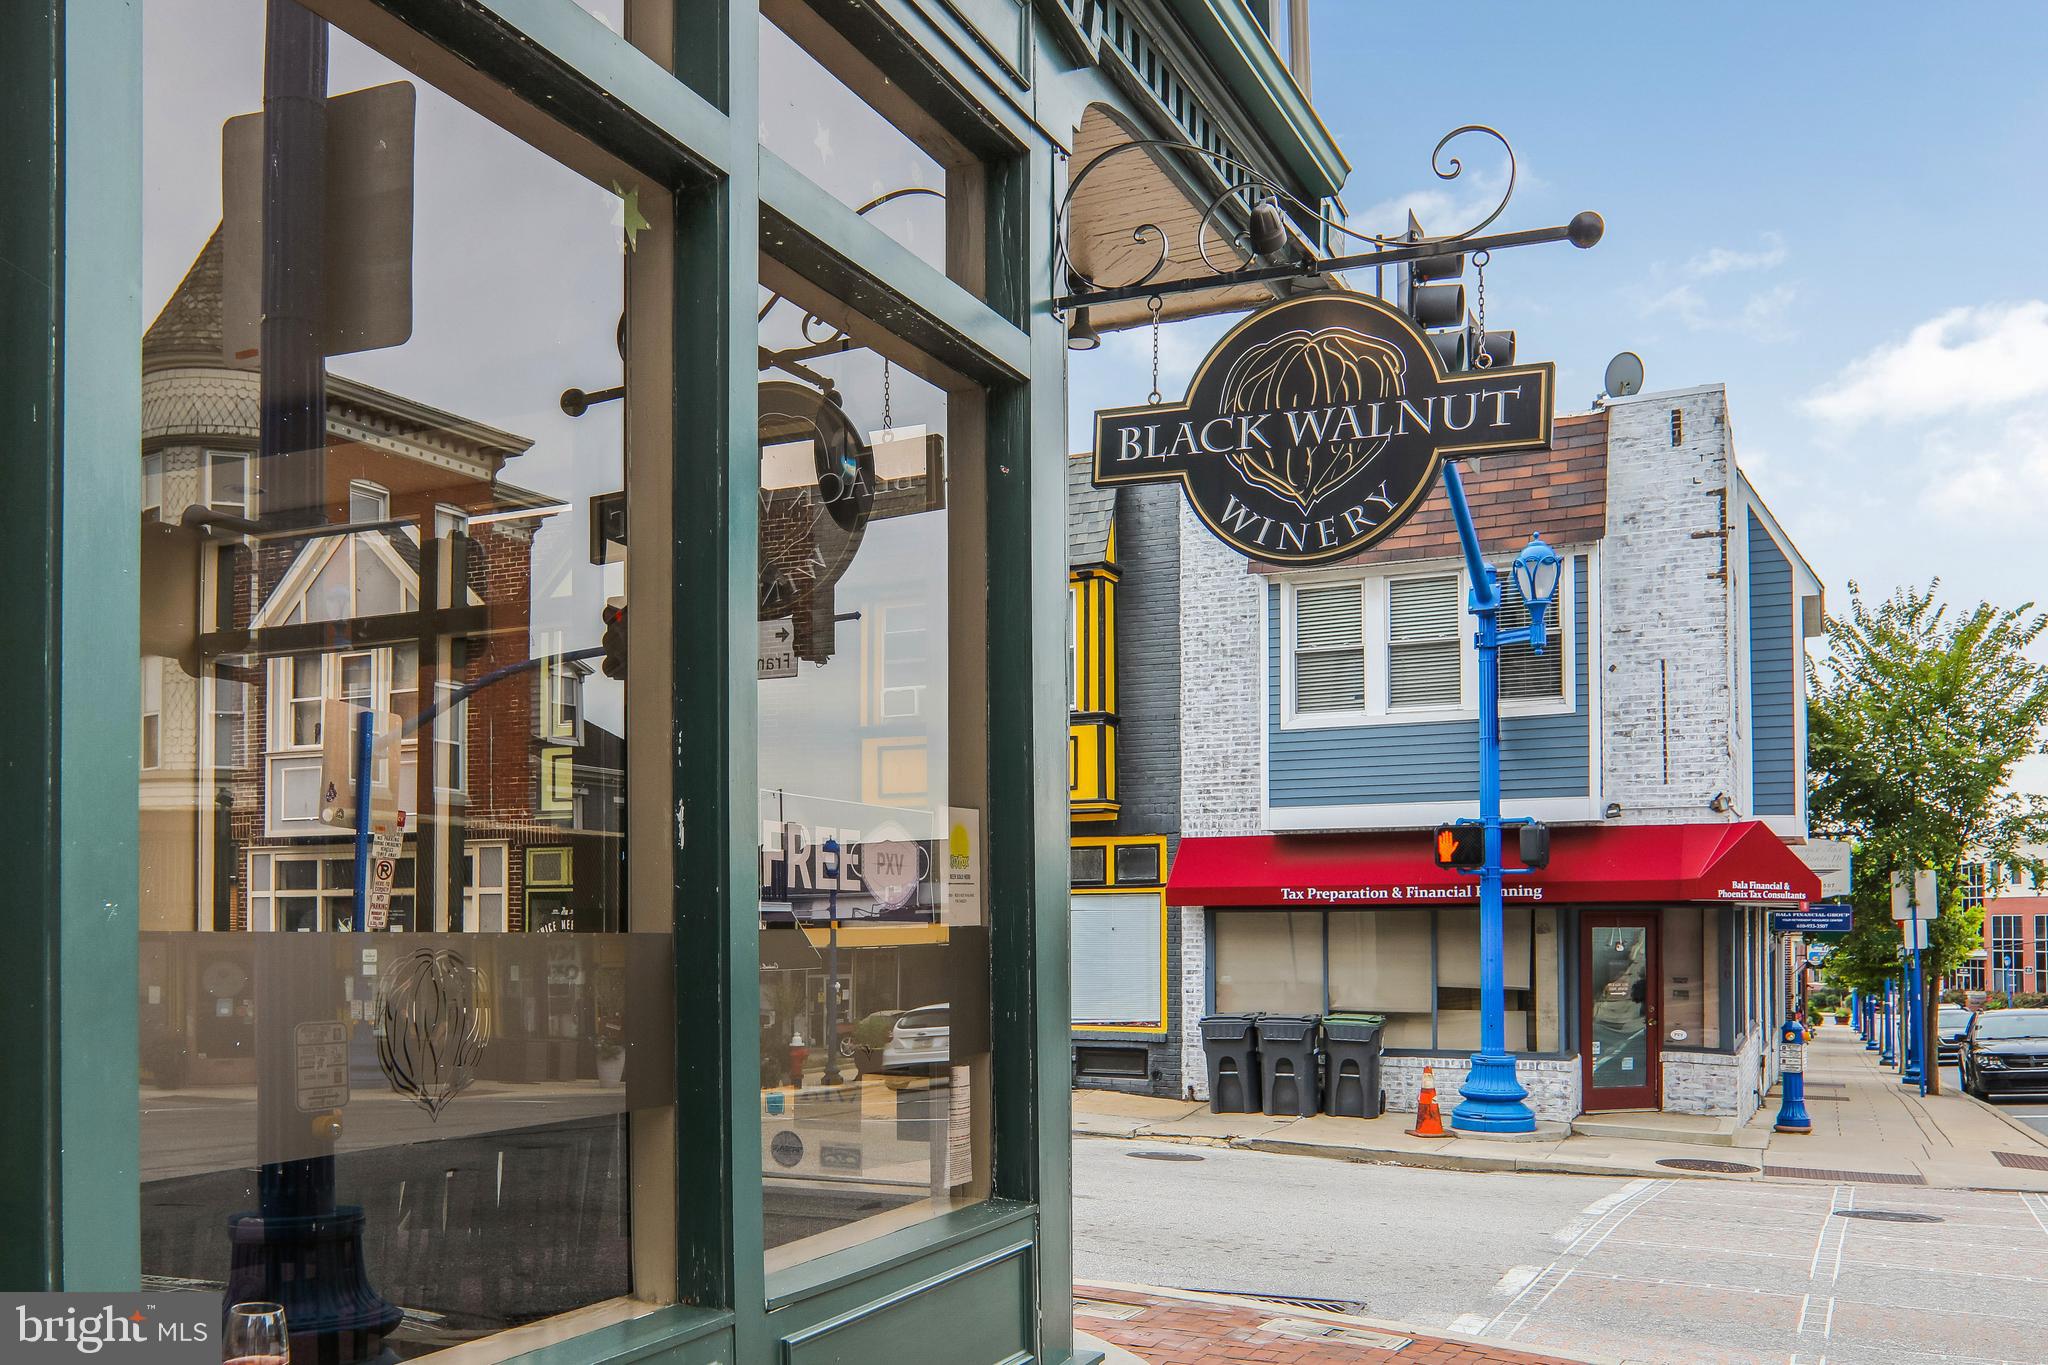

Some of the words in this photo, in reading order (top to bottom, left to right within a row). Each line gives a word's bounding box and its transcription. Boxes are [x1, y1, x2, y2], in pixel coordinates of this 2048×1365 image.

[1116, 413, 1273, 463] BLACK
[1284, 385, 1522, 446] WALNUT
[1220, 480, 1400, 552] WINERY
[762, 819, 861, 891] FREE
[877, 851, 904, 876] PXV
[1281, 887, 1305, 900] Tax
[1307, 887, 1390, 902] Preparation
[1392, 887, 1403, 899] &
[1406, 885, 1472, 899] Financial
[1476, 885, 1543, 900] Pnning
[1718, 890, 1748, 899] Phoenix
[1749, 890, 1762, 898] Tax
[1763, 890, 1806, 899] Consultants
[1732, 881, 1748, 889] Bala
[1750, 881, 1782, 890] Financial
[1784, 882, 1790, 890] &
[376, 894, 384, 902] NO
